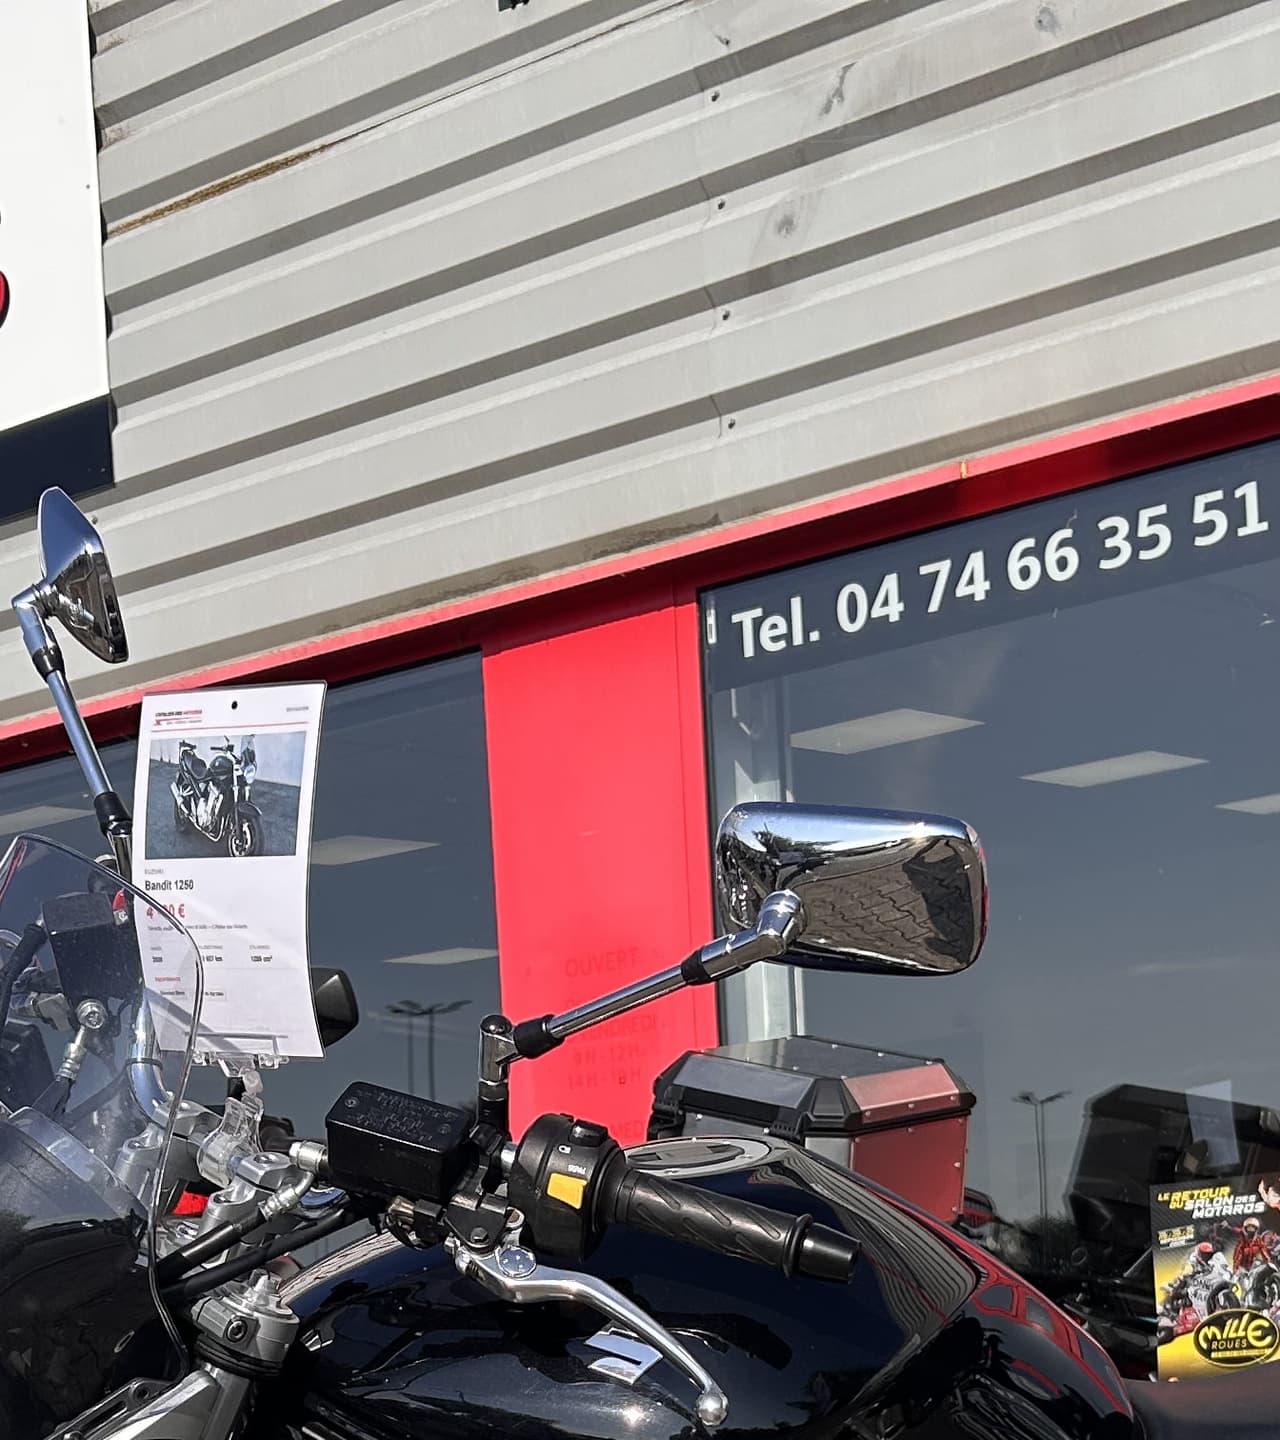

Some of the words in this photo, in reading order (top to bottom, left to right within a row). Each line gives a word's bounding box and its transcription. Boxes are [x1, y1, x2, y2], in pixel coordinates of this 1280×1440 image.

[731, 596, 821, 658] Tel.
[836, 572, 904, 633] 04
[918, 550, 991, 612] 74
[1006, 528, 1080, 592] 66
[1096, 503, 1173, 570] 35
[1191, 480, 1269, 547] 51
[145, 879, 172, 891] Bandit
[174, 879, 194, 890] 1250
[565, 947, 639, 978] OUVERT
[1170, 1186, 1231, 1202] RETOUR
[1183, 1195, 1234, 1211] SALON
[1191, 1201, 1266, 1219] MOTARDS
[1198, 1312, 1272, 1350] MILLE
[1211, 1338, 1247, 1350] ROUES
